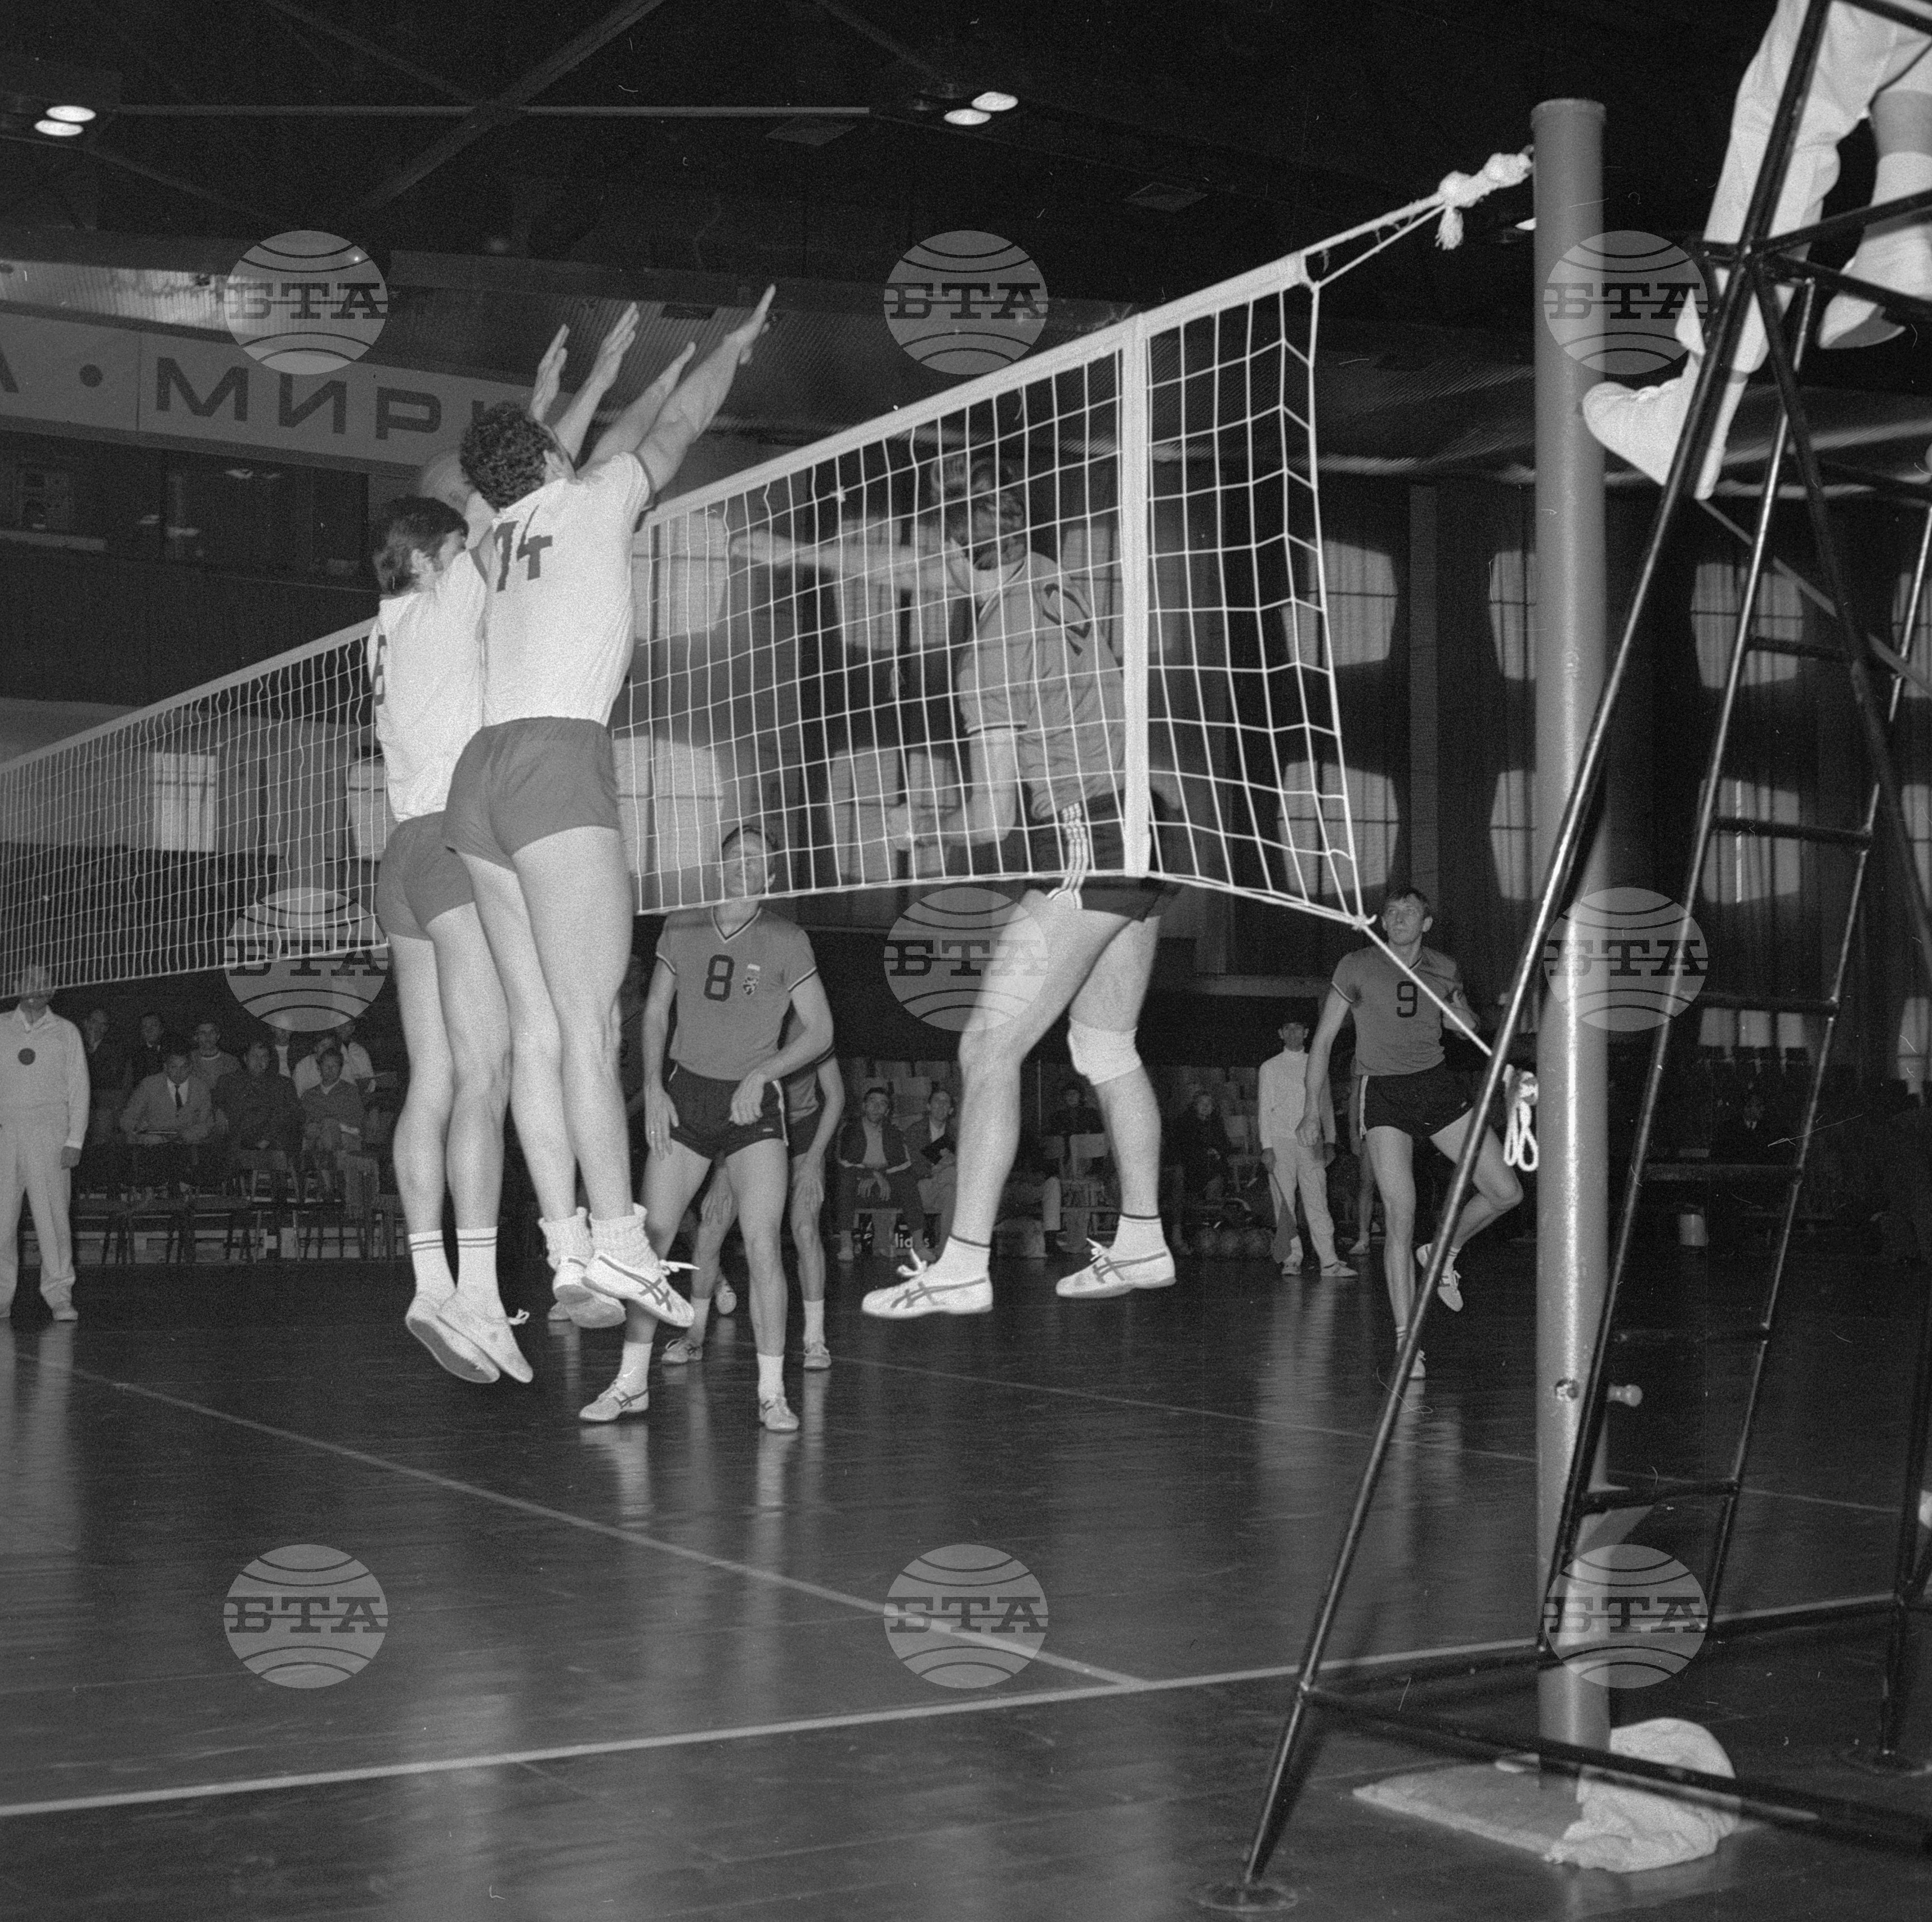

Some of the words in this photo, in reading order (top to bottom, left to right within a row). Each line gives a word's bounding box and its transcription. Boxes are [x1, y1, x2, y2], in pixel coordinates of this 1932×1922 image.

[156, 356, 484, 440] МИР
[494, 505, 553, 592] 14
[704, 954, 735, 1002] 8
[1396, 981, 1418, 1018] 9
